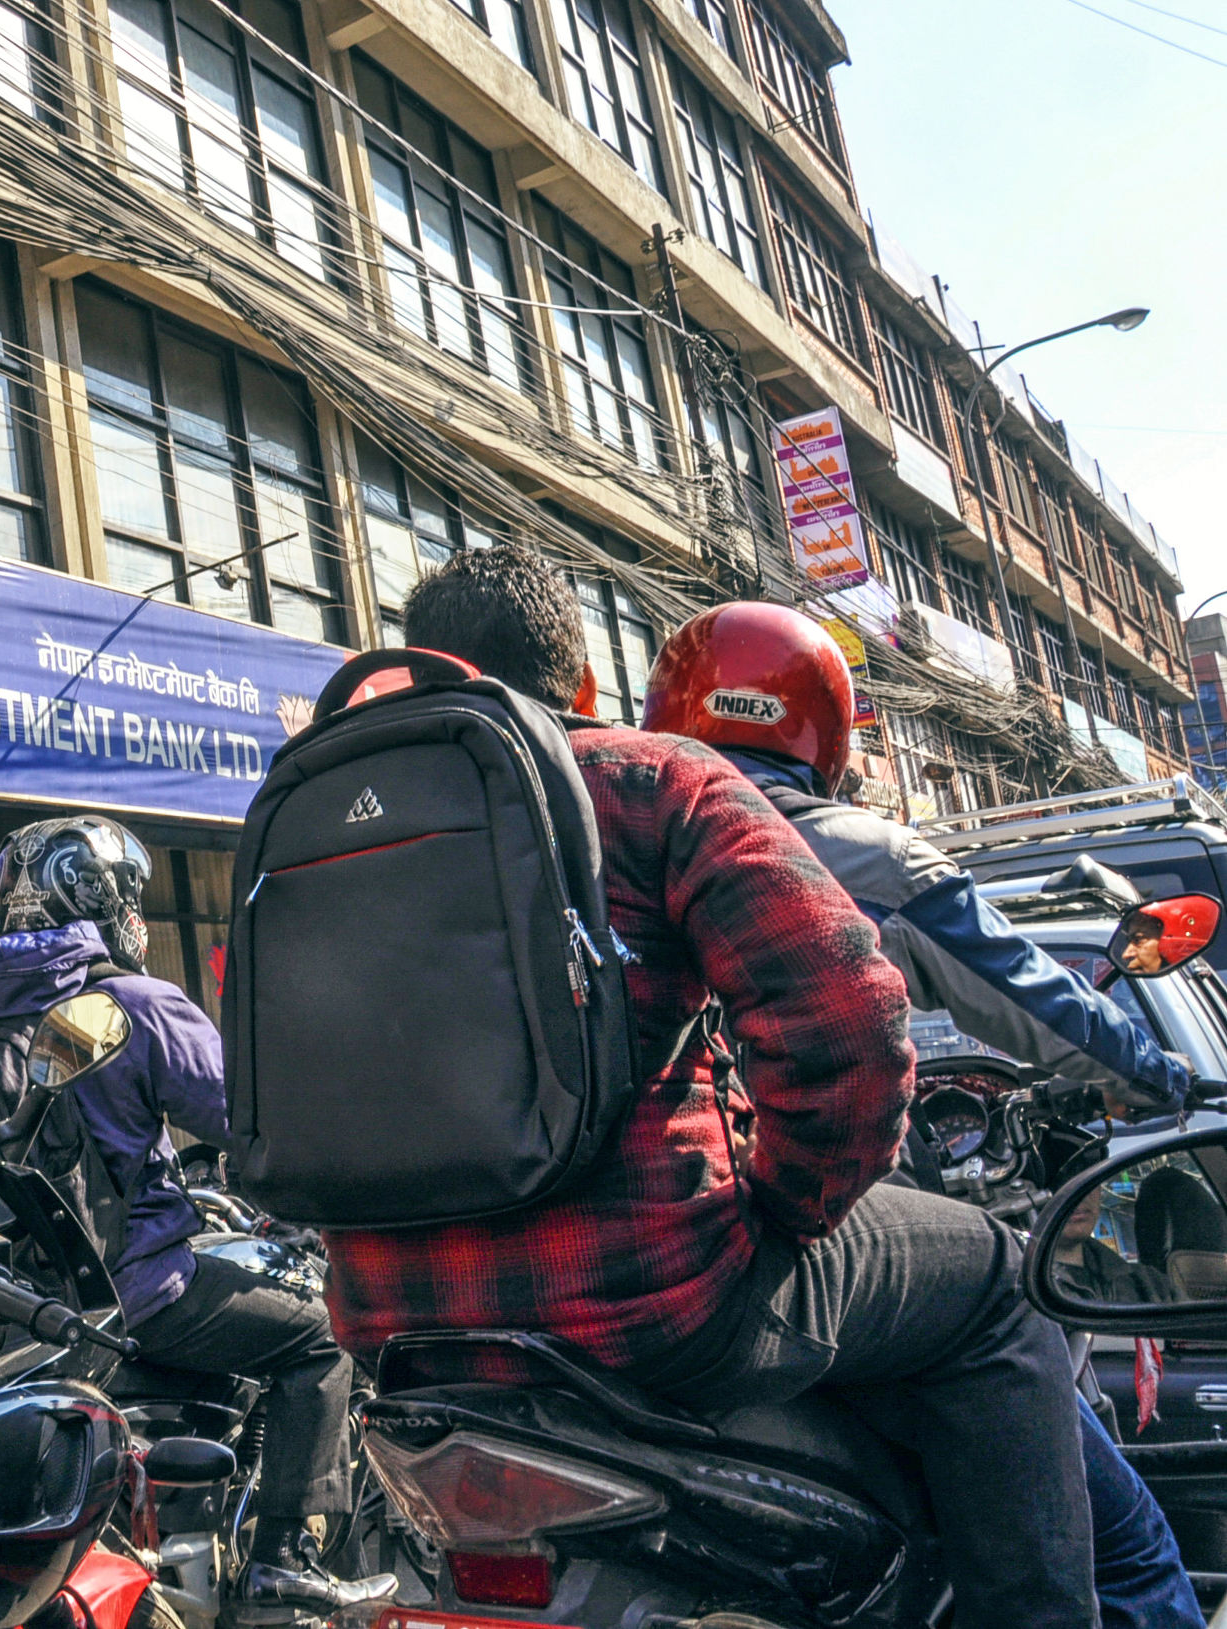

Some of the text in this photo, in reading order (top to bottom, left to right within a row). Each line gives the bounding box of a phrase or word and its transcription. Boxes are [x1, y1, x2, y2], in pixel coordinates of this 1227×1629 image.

[791, 429, 823, 442] AUSTRALIA
[35, 631, 94, 680] नेपाल
[205, 669, 238, 709] बैंक
[238, 677, 259, 715] लि
[714, 694, 775, 718] INDEX
[123, 712, 209, 774] BANK
